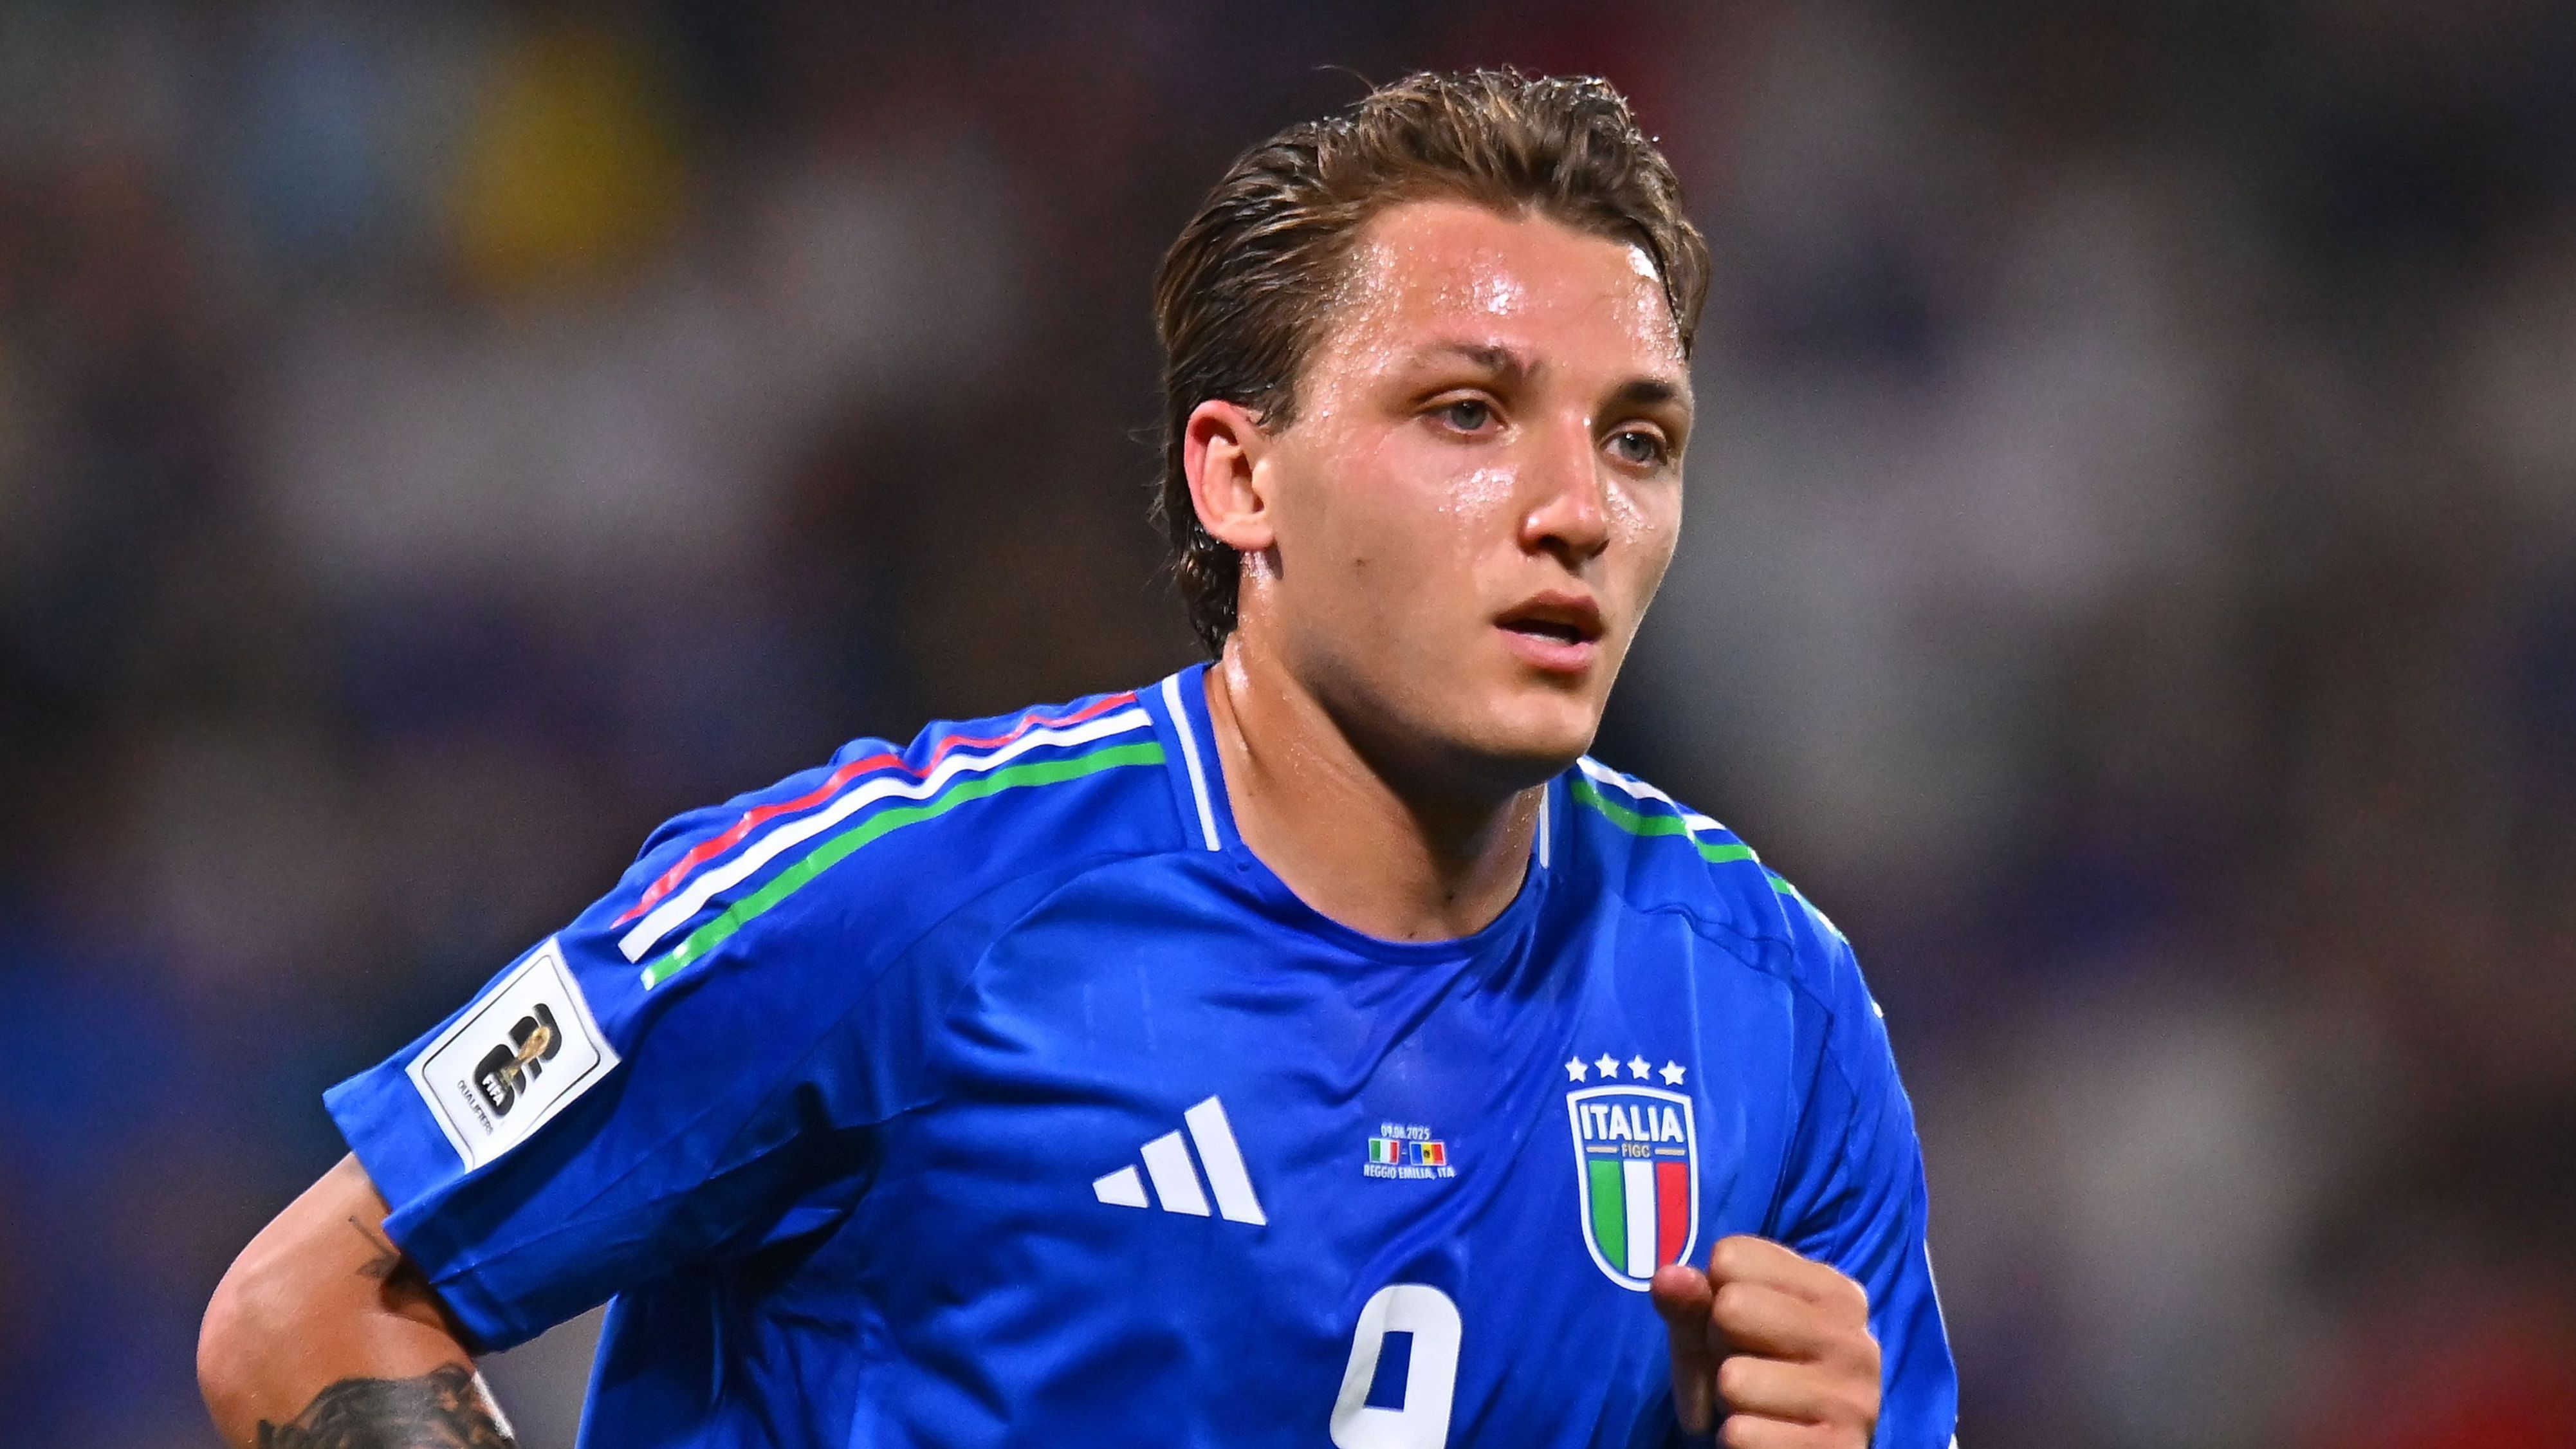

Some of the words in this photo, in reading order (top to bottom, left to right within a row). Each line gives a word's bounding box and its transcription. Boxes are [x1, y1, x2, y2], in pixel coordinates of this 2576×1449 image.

[457, 1080, 494, 1136] QUALIFIERS
[481, 1072, 507, 1107] FIFA
[1579, 1103, 1684, 1143] ITALIA
[1621, 1143, 1650, 1158] FIGC
[1363, 1164, 1397, 1179] REGGIO
[1398, 1166, 1437, 1181] EMILIA,
[1437, 1165, 1457, 1178] ITA
[1329, 1284, 1462, 1449] 9
